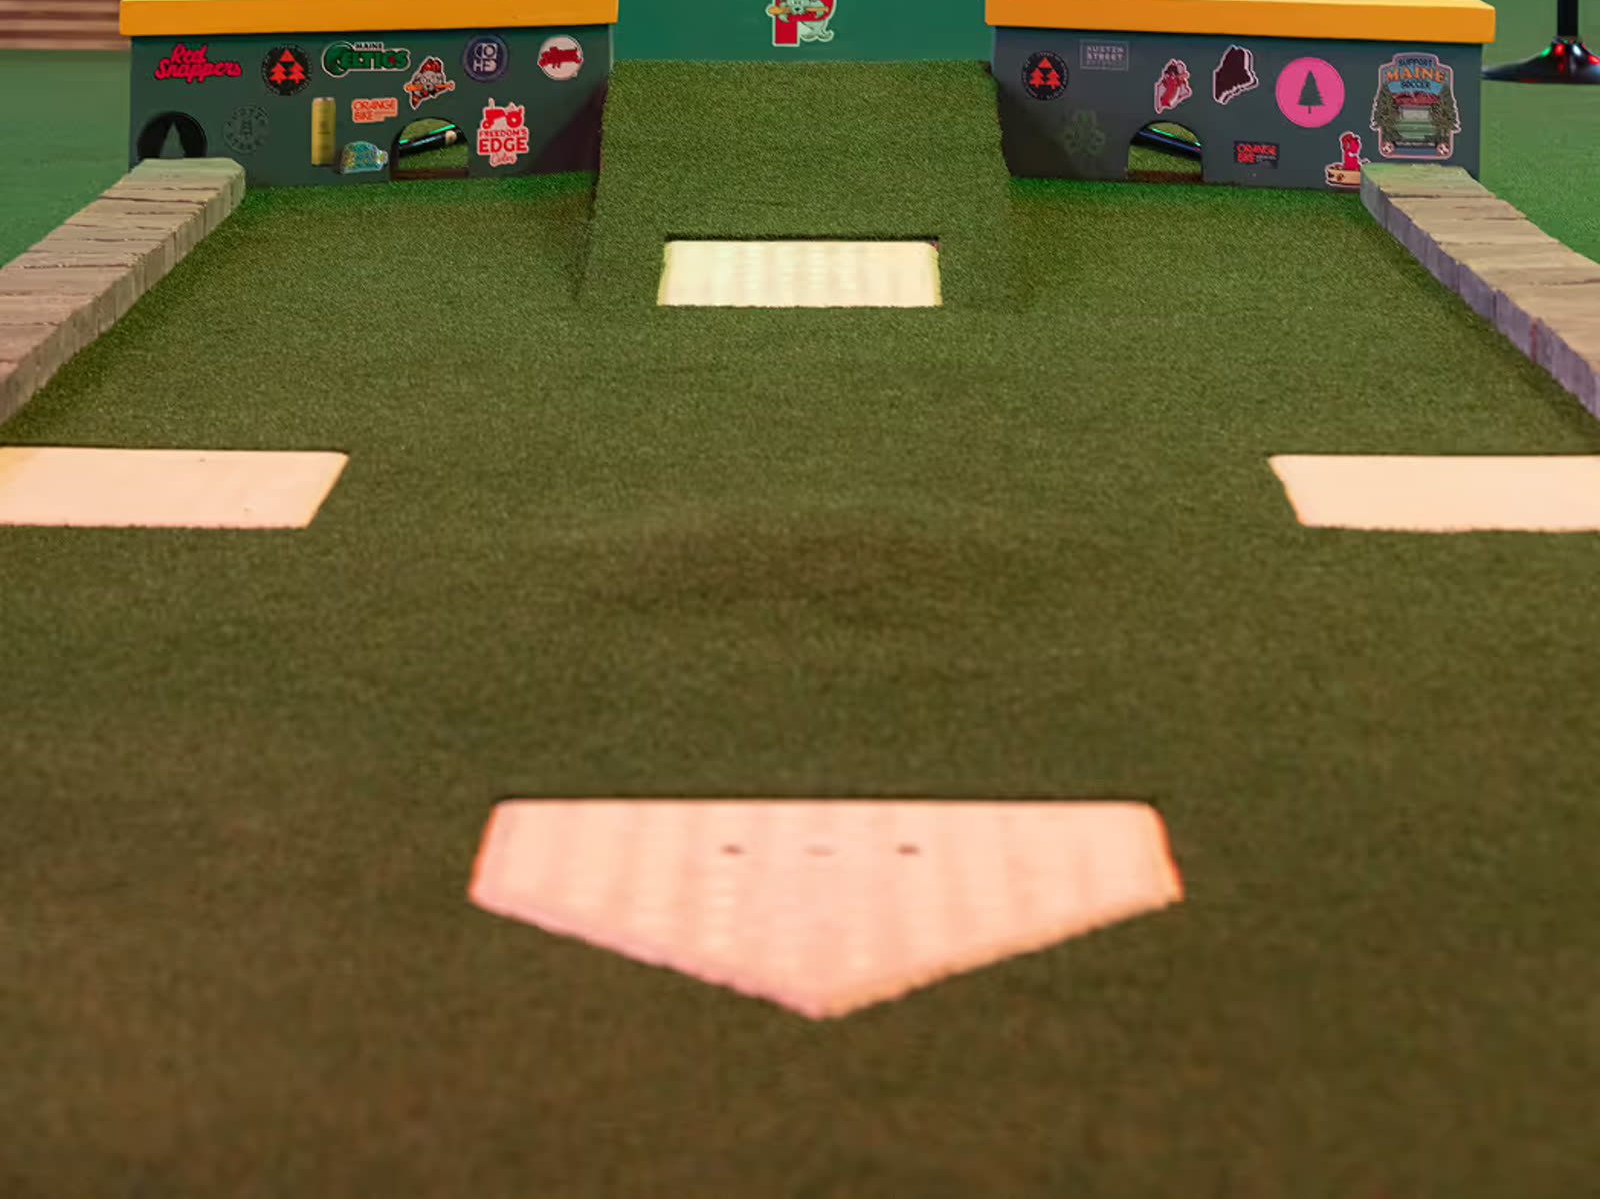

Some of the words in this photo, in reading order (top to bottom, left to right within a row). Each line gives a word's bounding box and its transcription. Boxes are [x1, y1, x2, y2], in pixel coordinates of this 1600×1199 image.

[170, 44, 207, 63] Red
[1087, 45, 1124, 53] AUSTIN
[1087, 53, 1124, 61] STREET
[155, 58, 242, 83] Snappers
[1386, 66, 1446, 83] MAINE
[353, 100, 395, 110] ORANGE
[479, 136, 527, 154] EDGE
